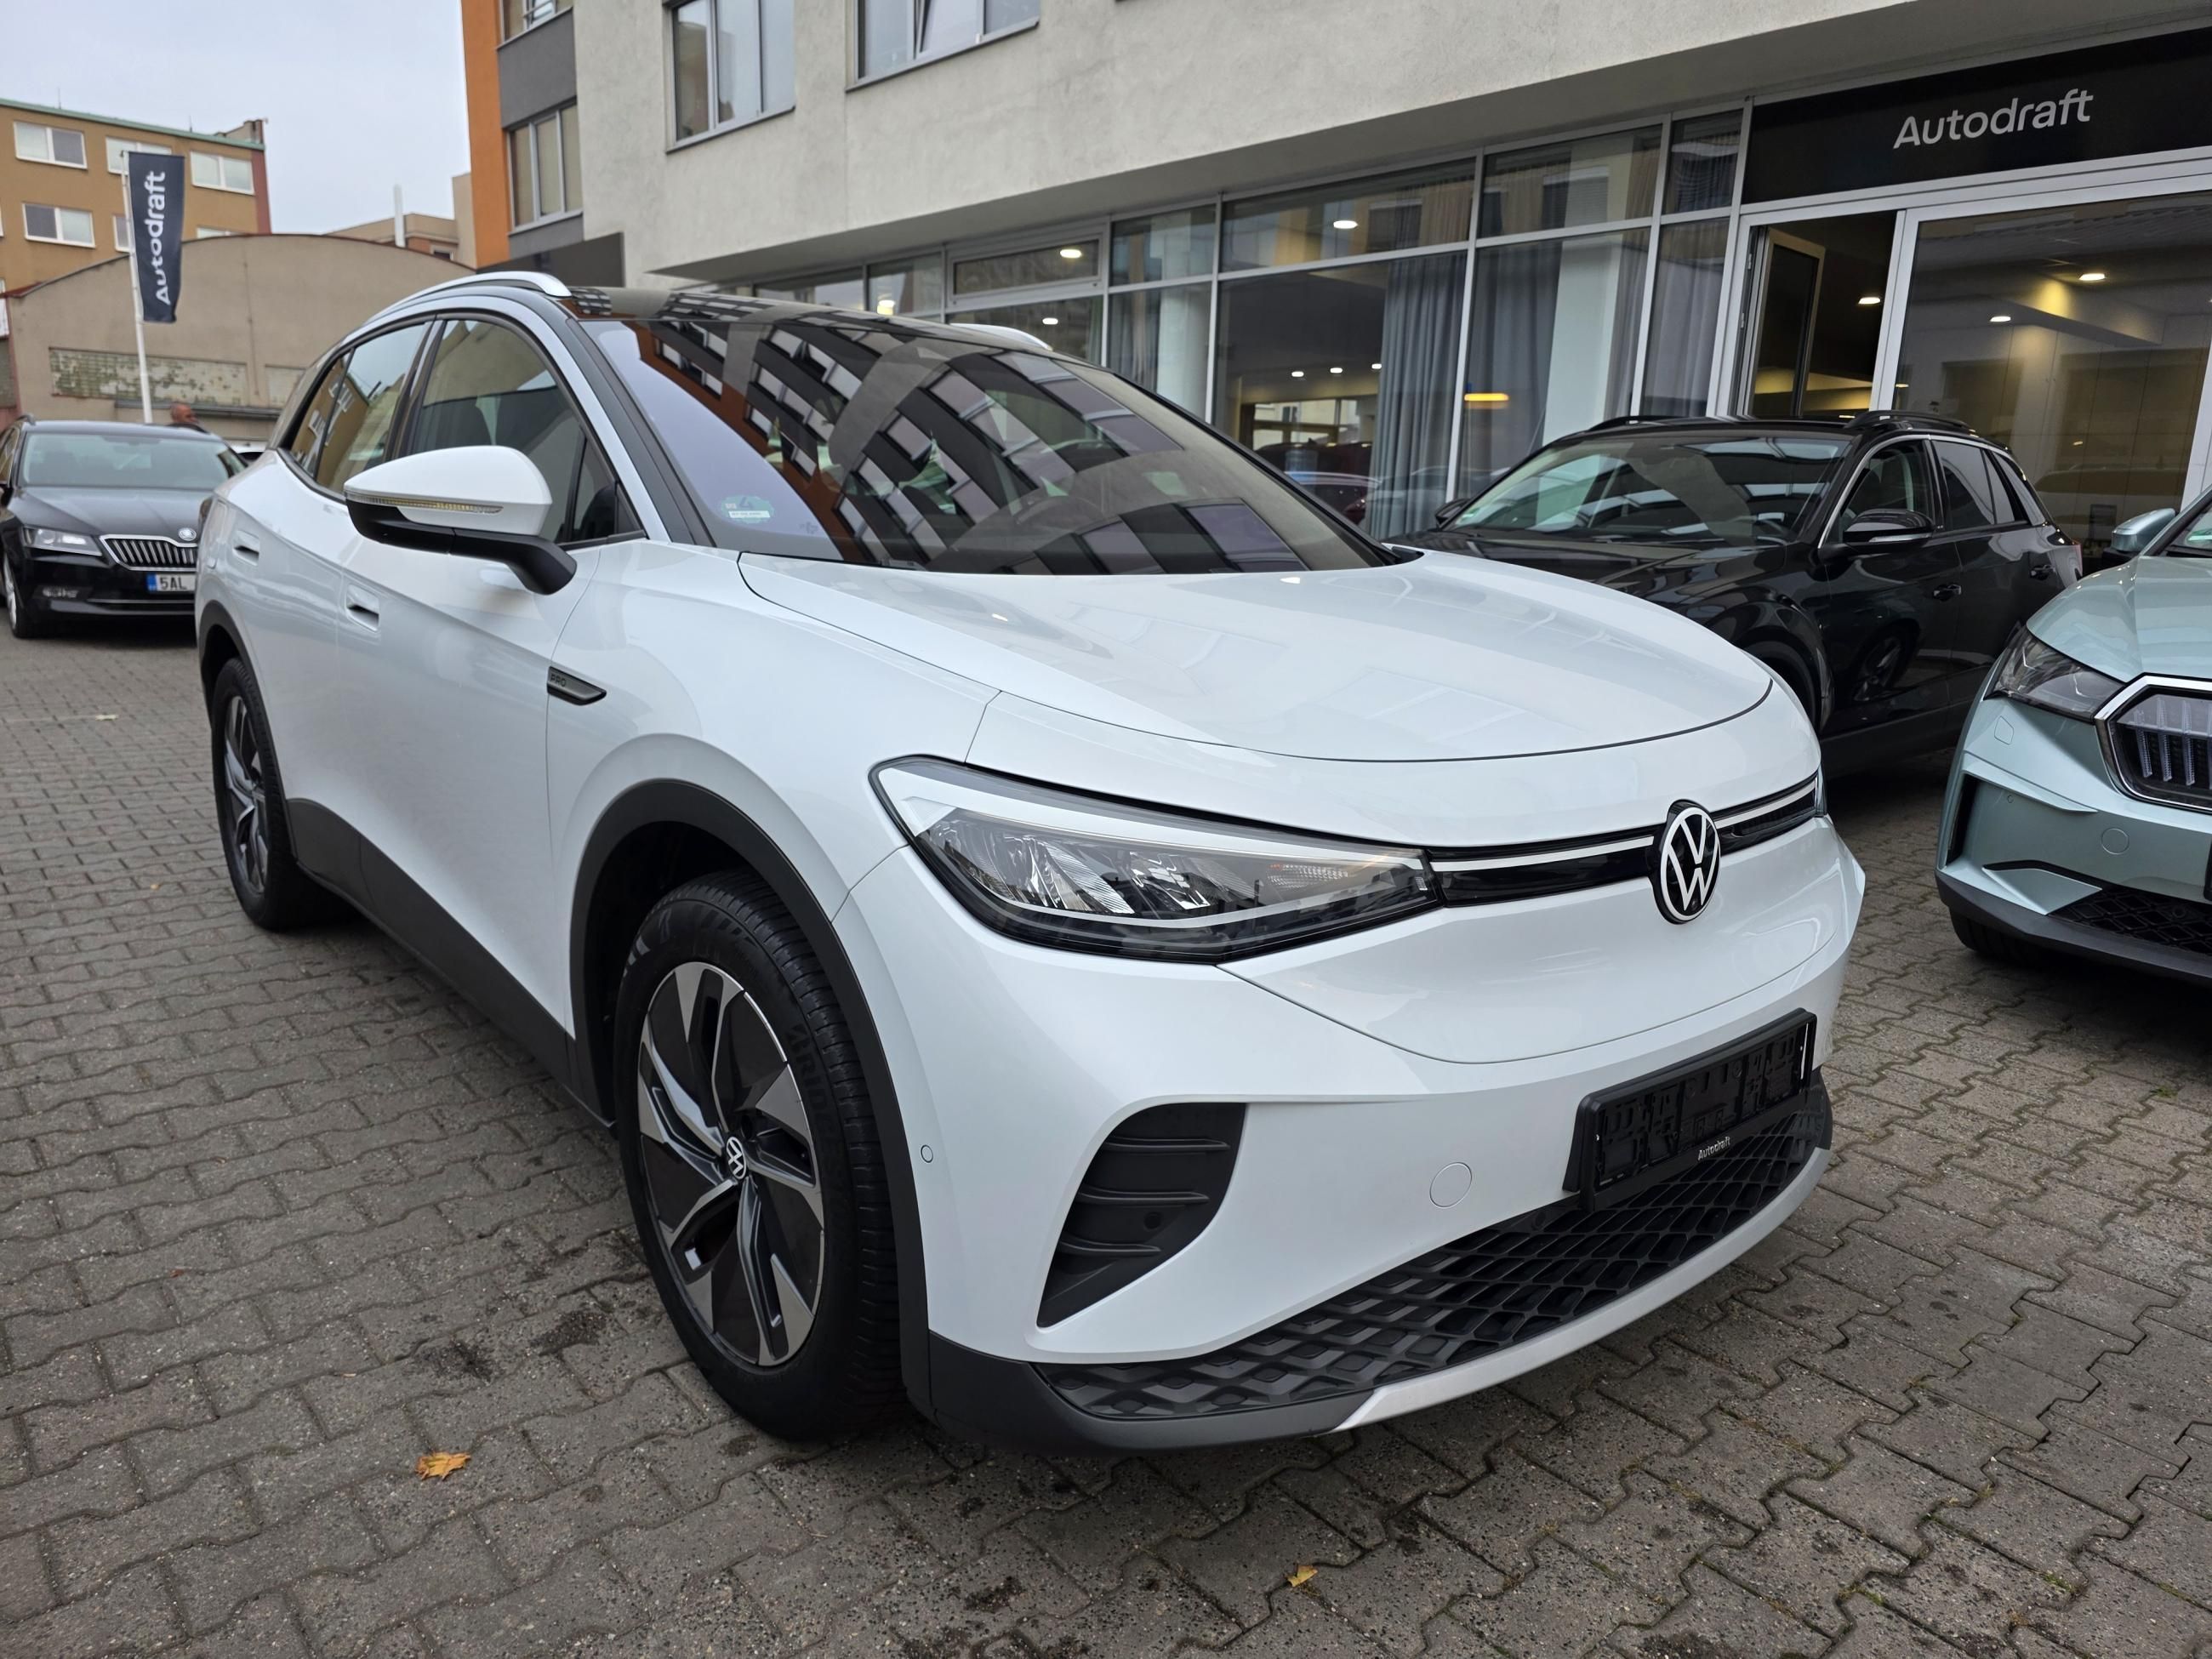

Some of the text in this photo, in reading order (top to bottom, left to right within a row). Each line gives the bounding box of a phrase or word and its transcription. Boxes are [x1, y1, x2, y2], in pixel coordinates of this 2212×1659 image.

[1893, 88, 2094, 149] Autodraft
[144, 170, 171, 305] Autodraft
[159, 576, 187, 590] 5AL
[550, 673, 567, 687] PRO
[1697, 1136, 1730, 1161] Autodraft
